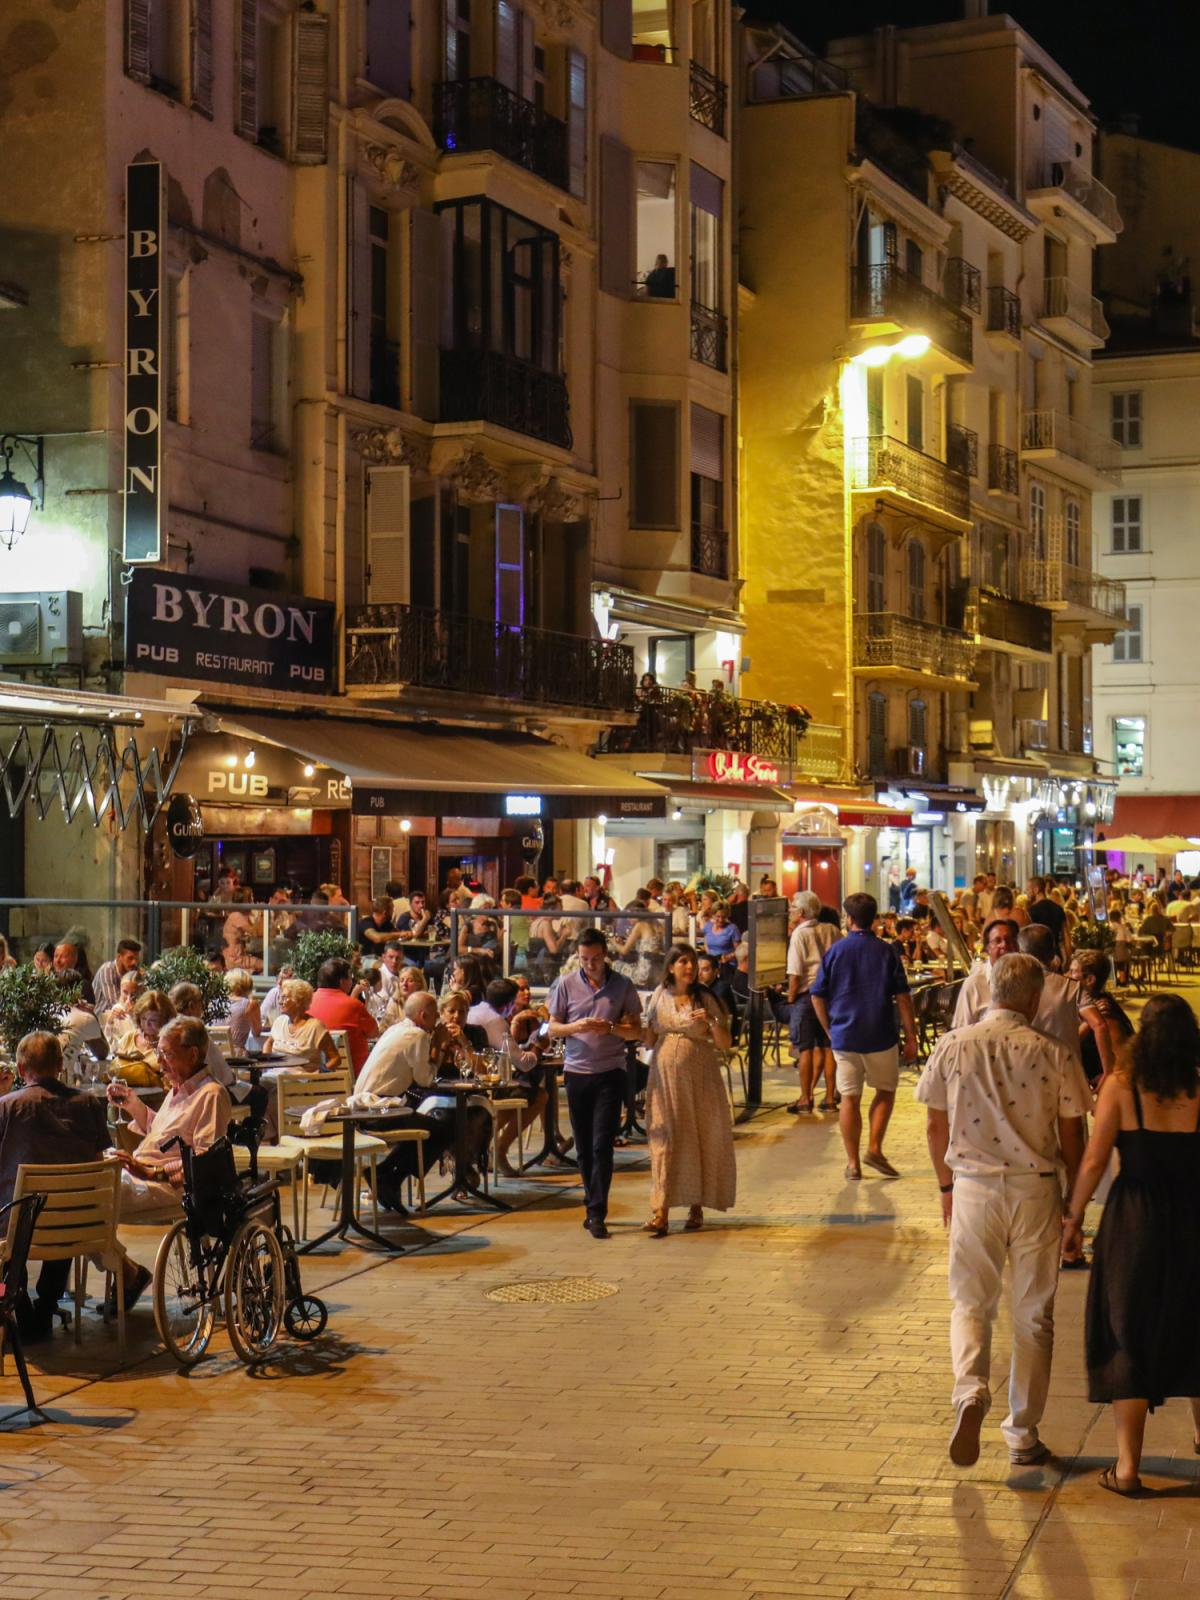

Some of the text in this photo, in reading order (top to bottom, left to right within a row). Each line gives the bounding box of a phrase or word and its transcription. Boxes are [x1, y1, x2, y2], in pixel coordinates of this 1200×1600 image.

[126, 229, 160, 495] BYRON
[151, 583, 317, 644] BYRON
[136, 643, 325, 682] PUB RESTAURANT PUB
[207, 771, 352, 799] PUB RE
[369, 796, 385, 808] PUB
